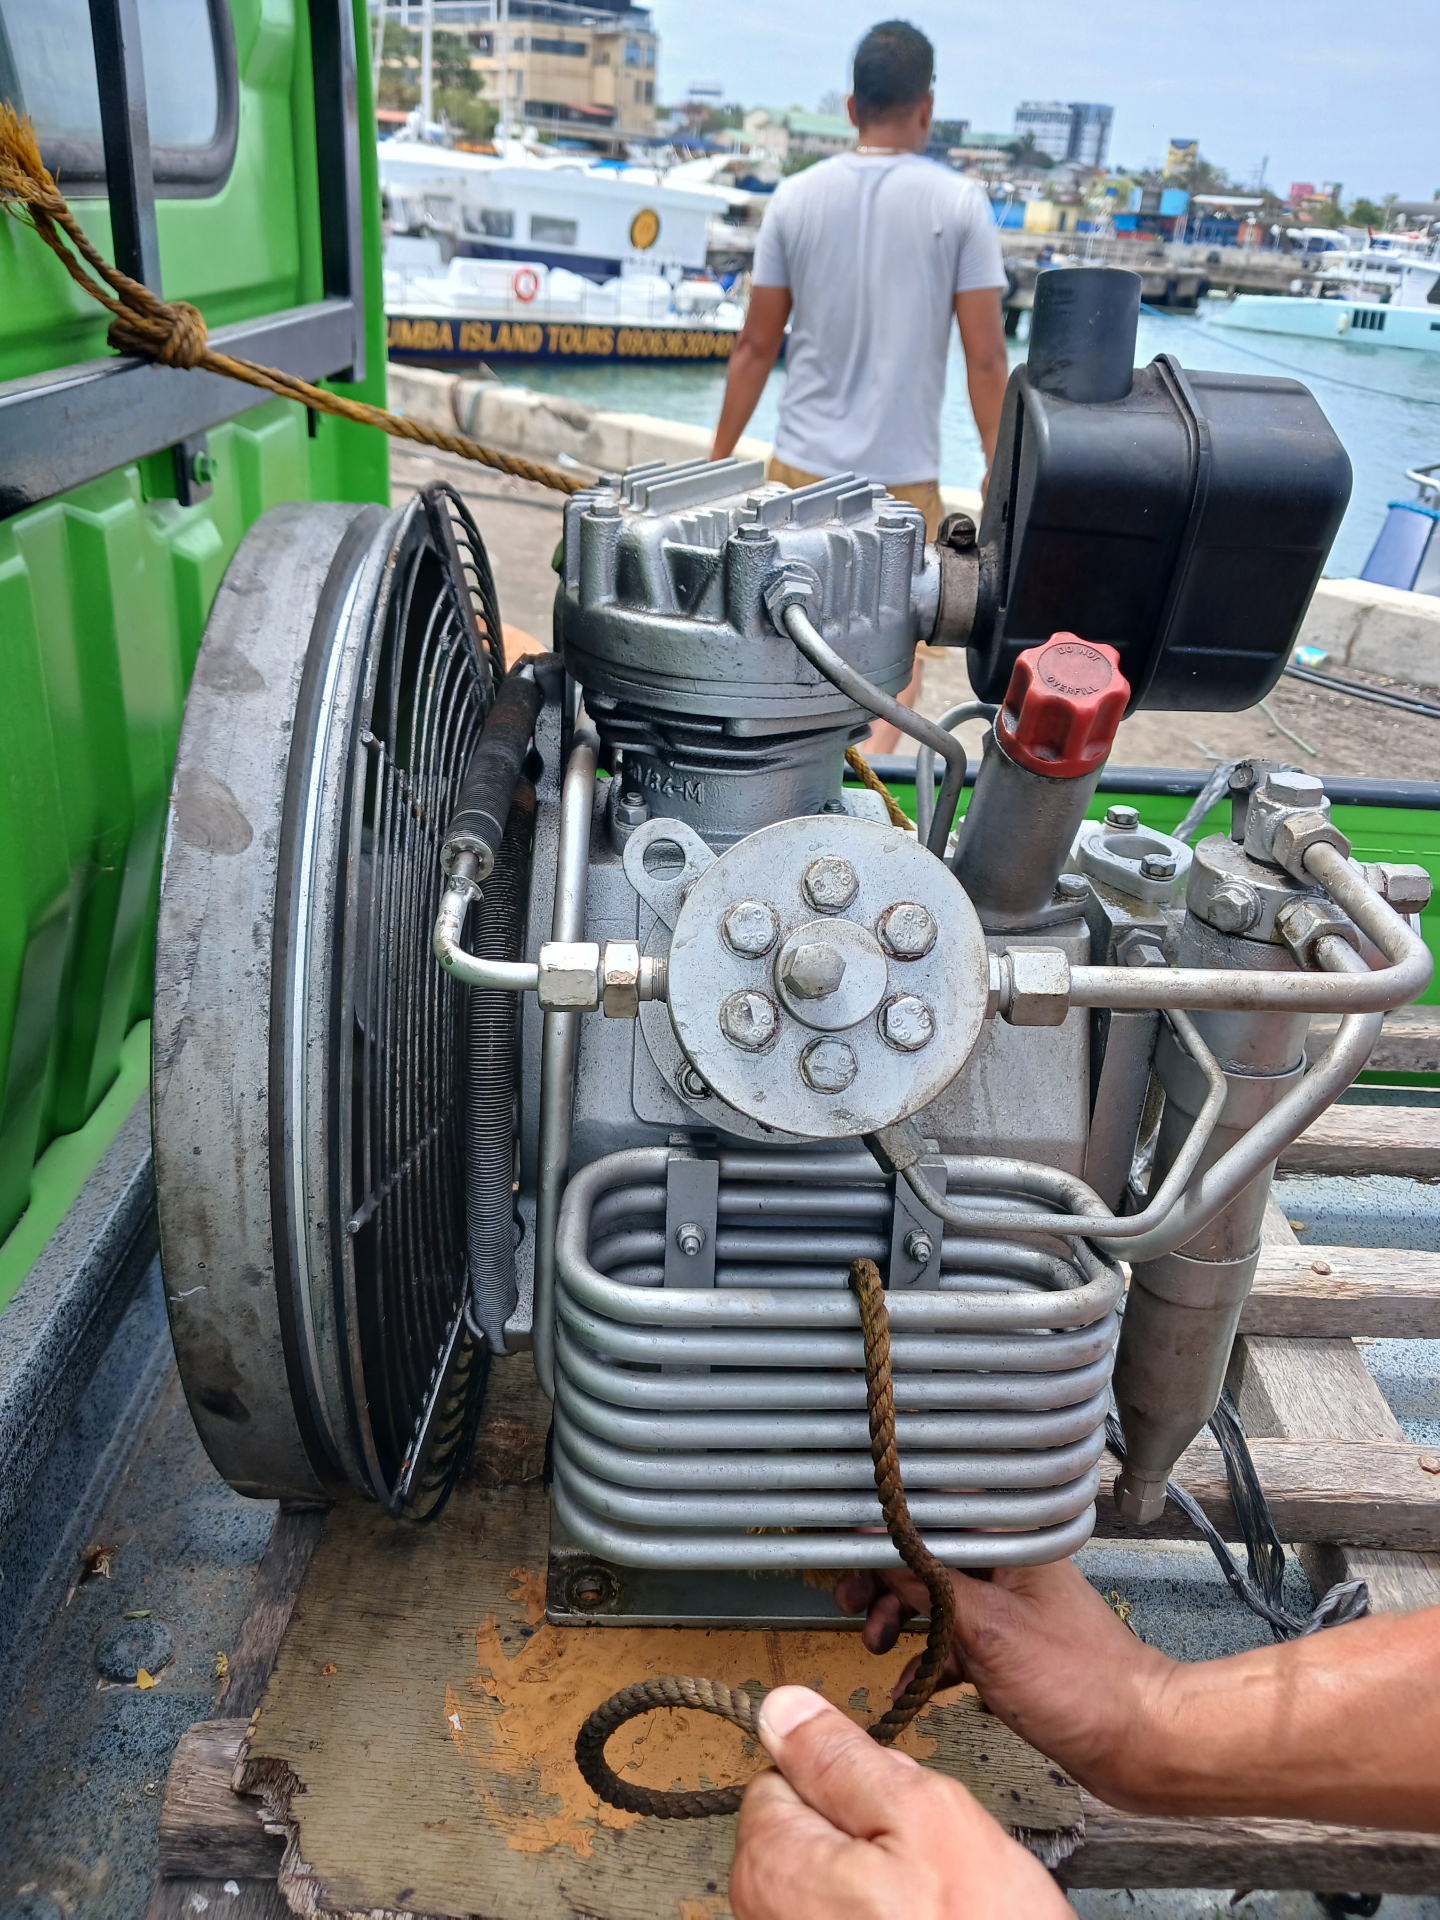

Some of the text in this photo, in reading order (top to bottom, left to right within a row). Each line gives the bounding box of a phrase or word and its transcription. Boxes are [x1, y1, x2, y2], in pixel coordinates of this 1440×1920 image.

[459, 320, 543, 353] ISLAND
[546, 323, 615, 355] TOURS
[1057, 645, 1101, 662] DO NOT
[1046, 675, 1100, 695] OVERFILL
